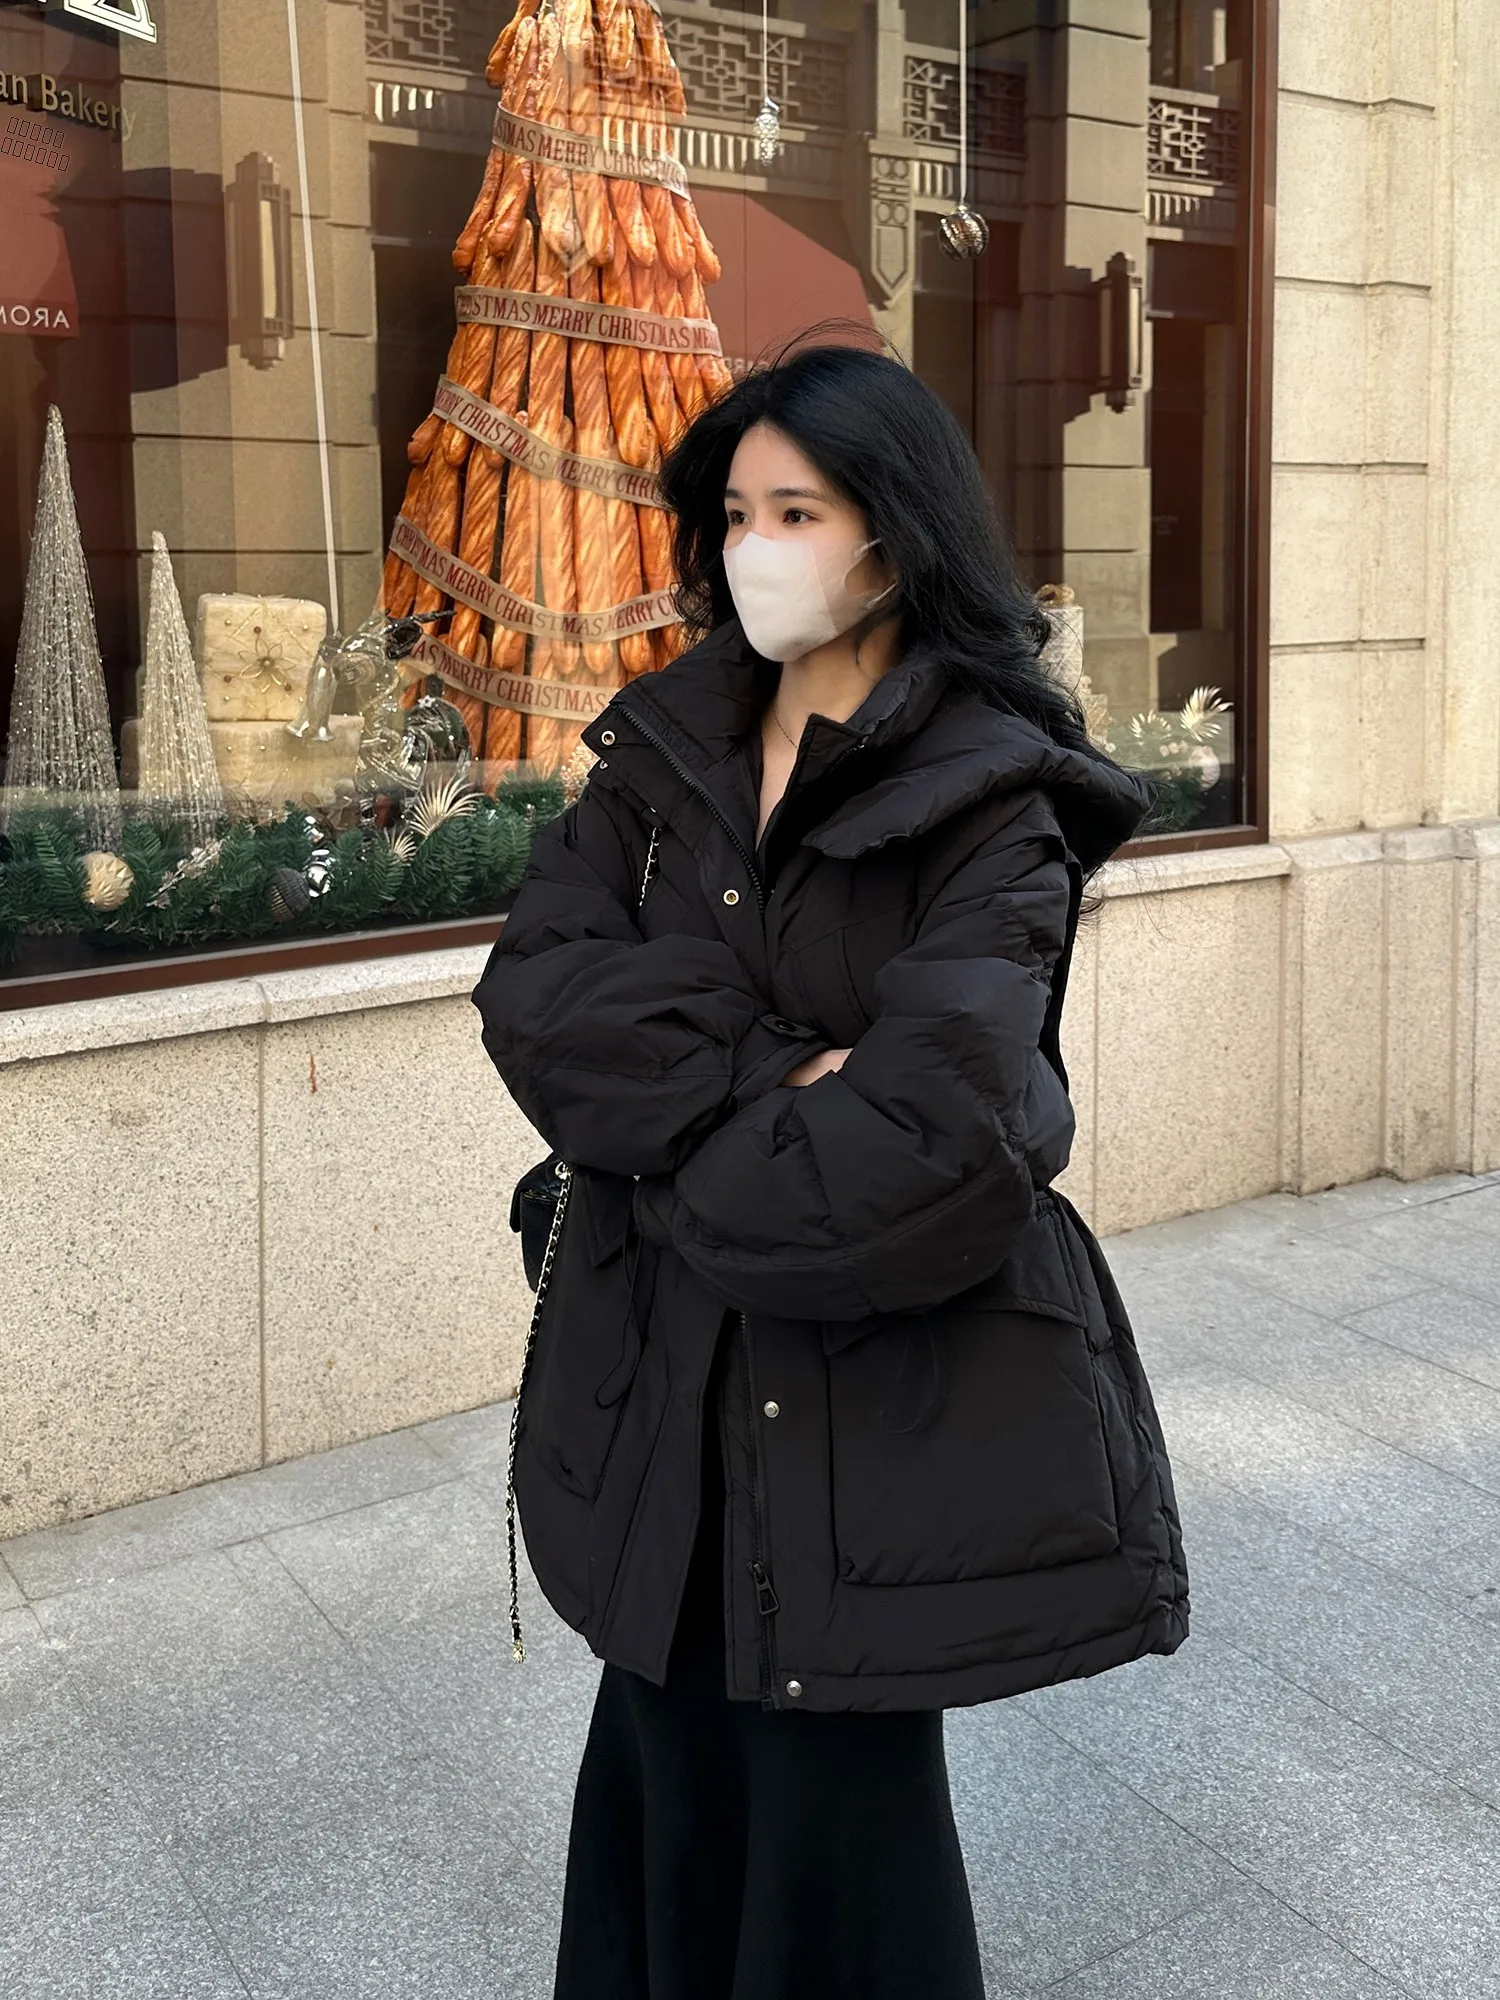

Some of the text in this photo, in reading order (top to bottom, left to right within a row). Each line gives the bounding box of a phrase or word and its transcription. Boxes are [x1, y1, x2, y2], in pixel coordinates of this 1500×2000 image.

[41, 73, 137, 142] Bakery
[538, 133, 600, 167] MERRY
[534, 305, 595, 335] MERRY
[599, 313, 690, 349] CHRISTMAS
[458, 402, 550, 471] CHRISTMAS
[552, 457, 616, 490] MERRY
[396, 523, 447, 578] CHRISTMAS
[445, 565, 496, 608] MERRY
[495, 594, 601, 636] CHRISTMAS
[439, 653, 494, 693] MERRY
[496, 677, 607, 714] CHRISTMAS
